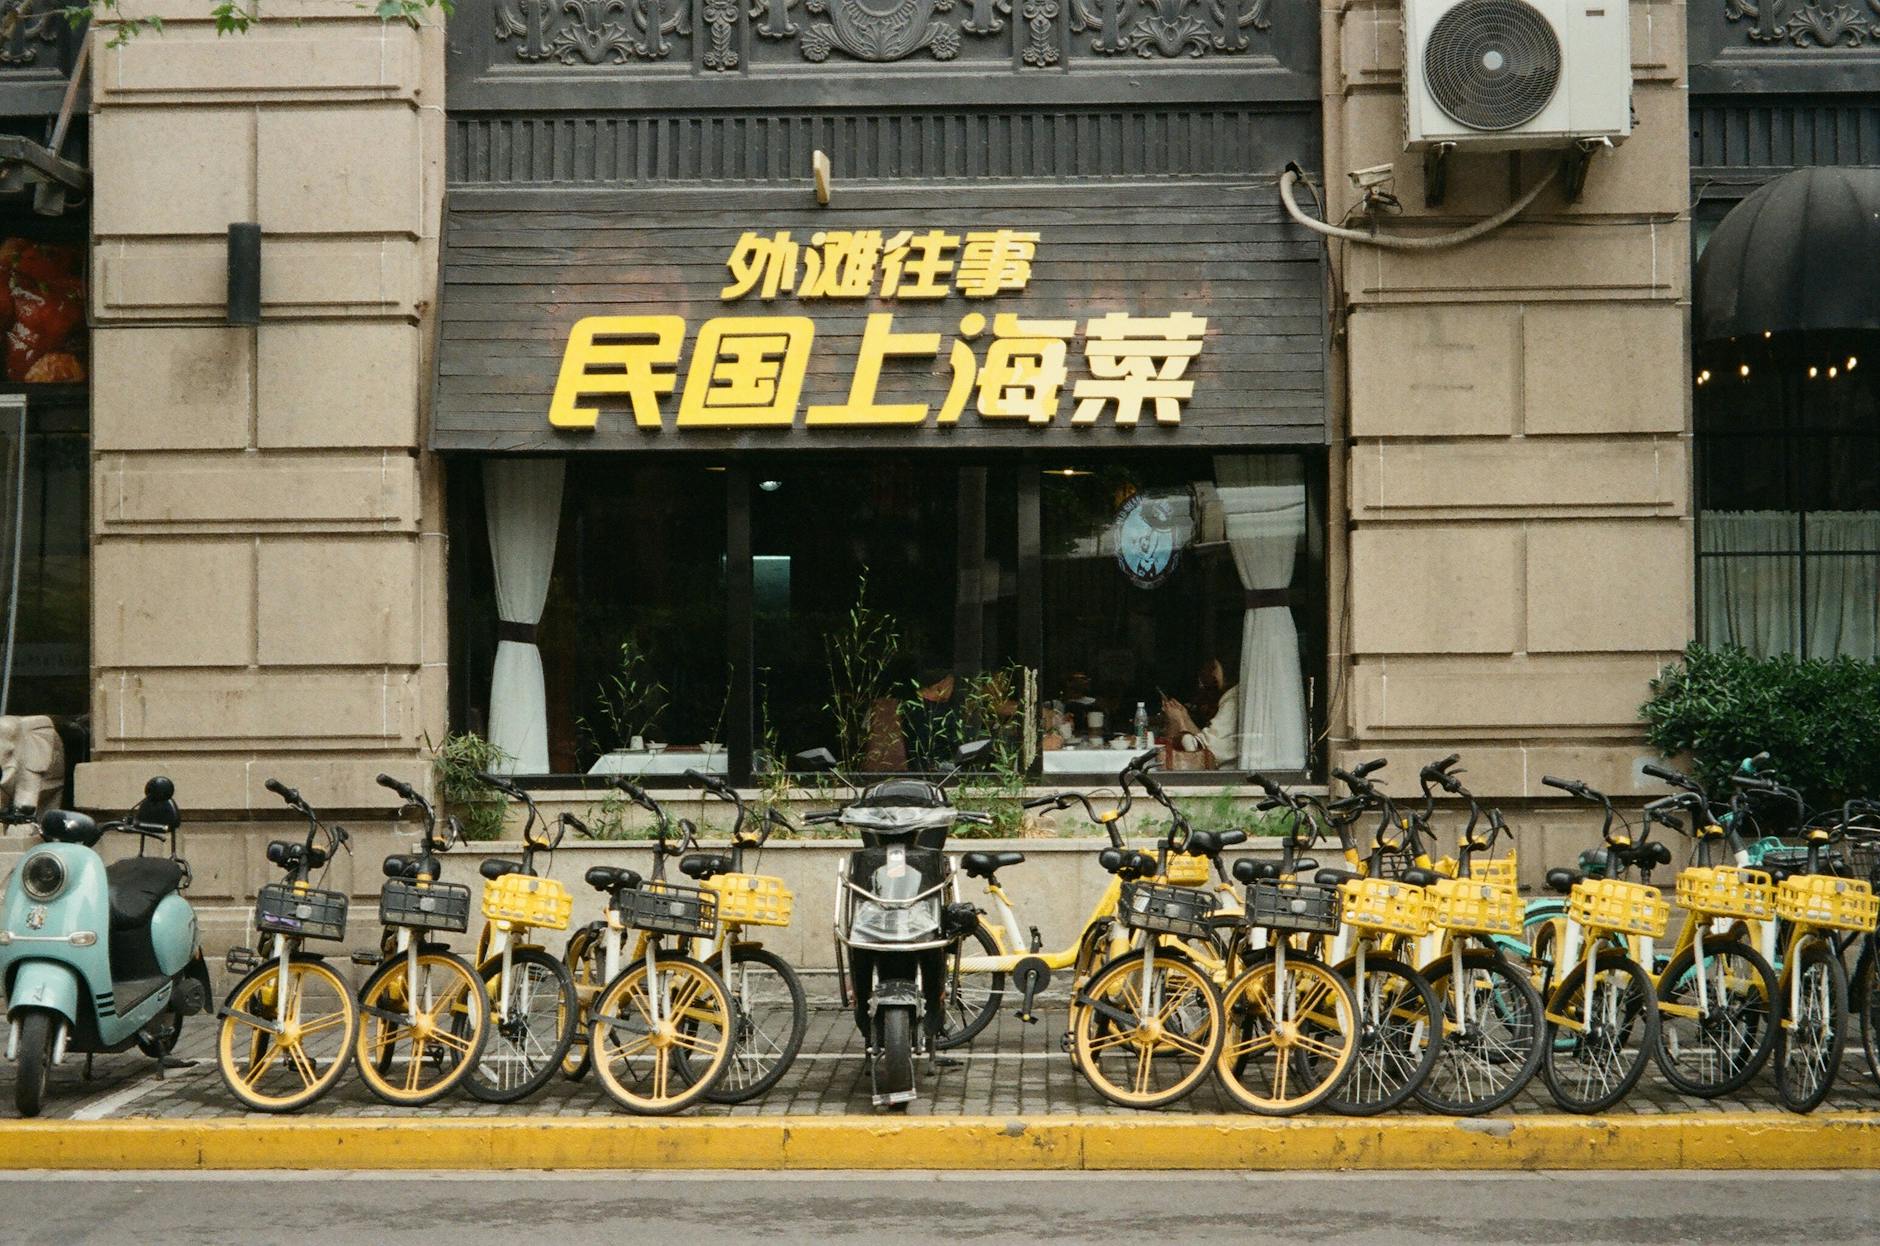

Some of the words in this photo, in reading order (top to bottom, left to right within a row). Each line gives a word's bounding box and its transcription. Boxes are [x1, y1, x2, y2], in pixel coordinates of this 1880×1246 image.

[720, 229, 1041, 299] 外滩往事
[548, 312, 1209, 428] 民国上海菜
